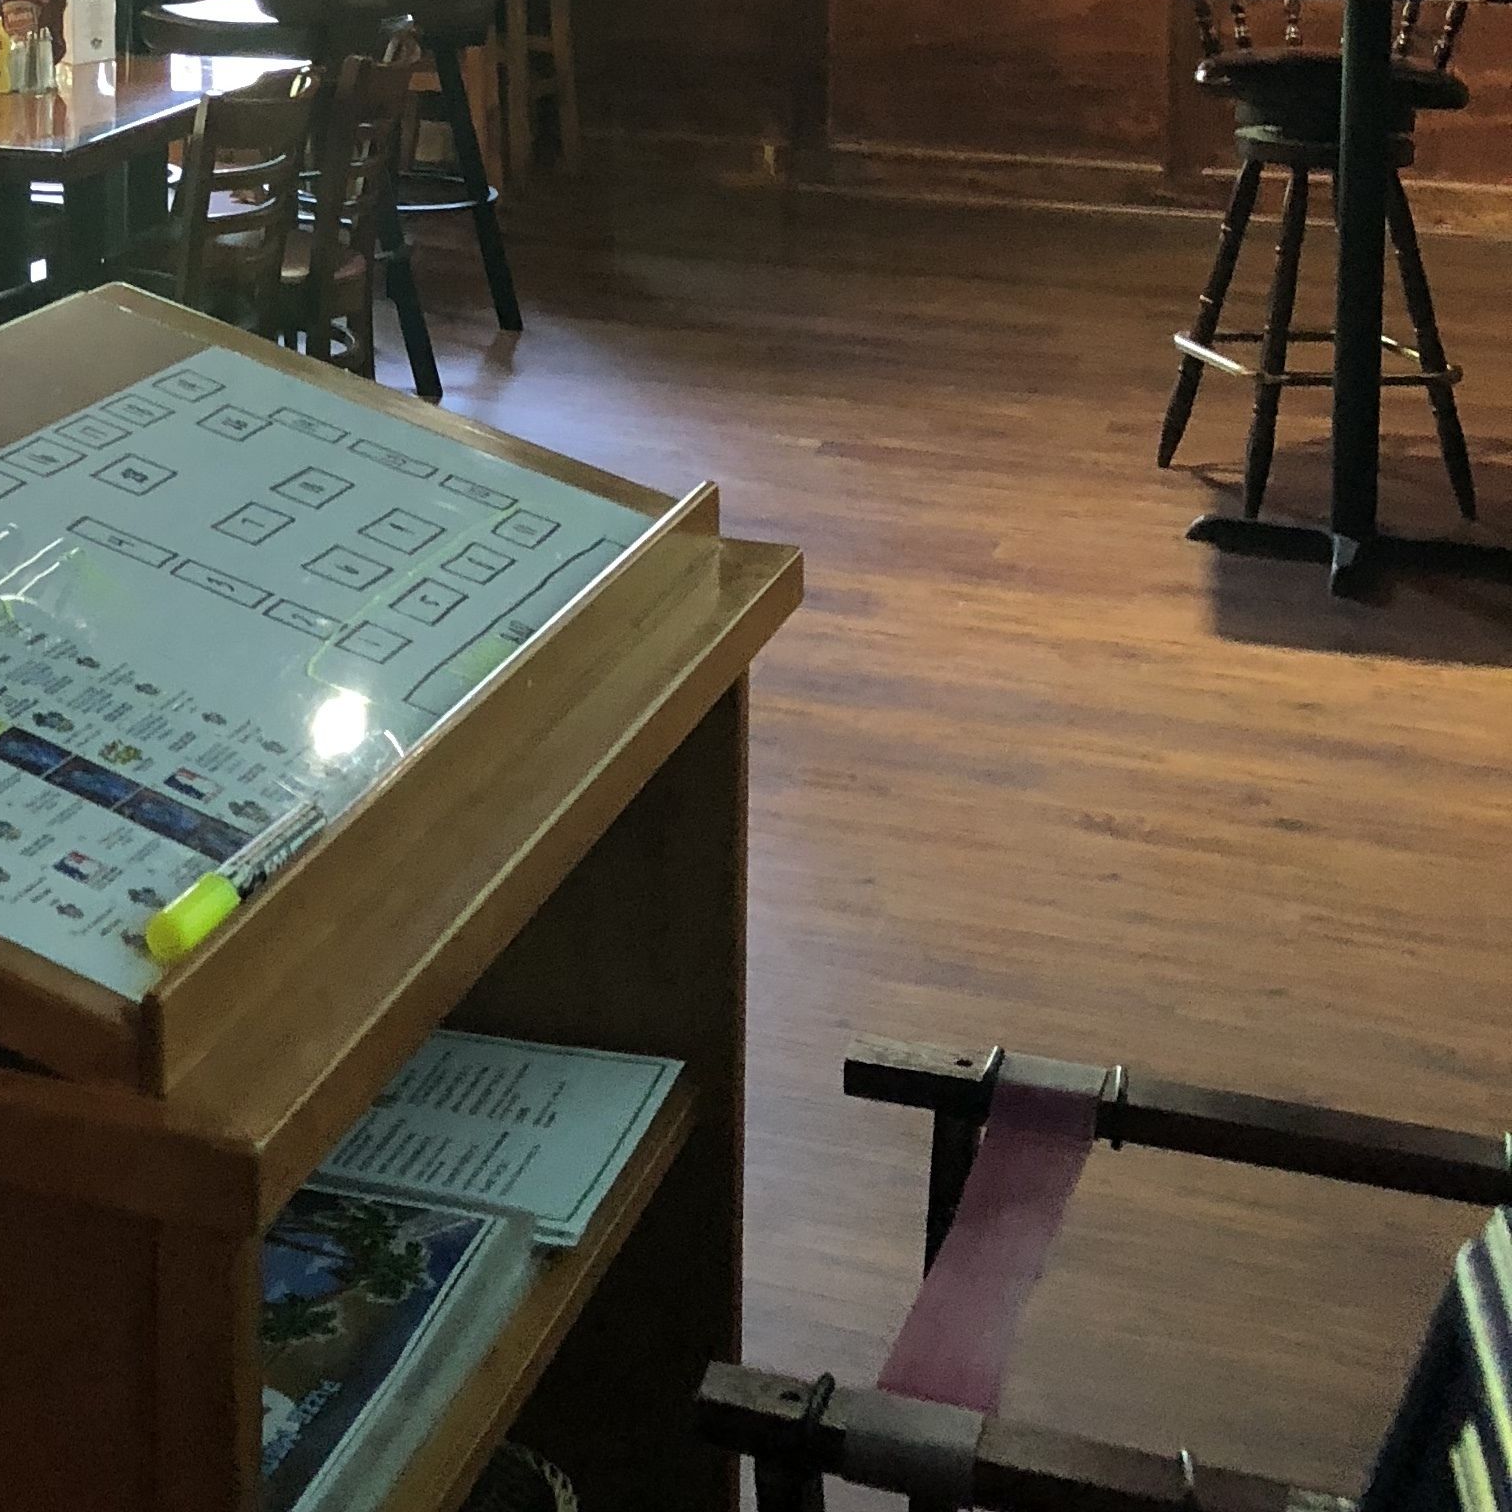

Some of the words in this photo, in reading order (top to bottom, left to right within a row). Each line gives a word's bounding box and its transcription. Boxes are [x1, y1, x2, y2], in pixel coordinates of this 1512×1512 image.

[240, 516, 266, 529] 7
[207, 576, 236, 593] 3
[418, 593, 441, 607] 5
